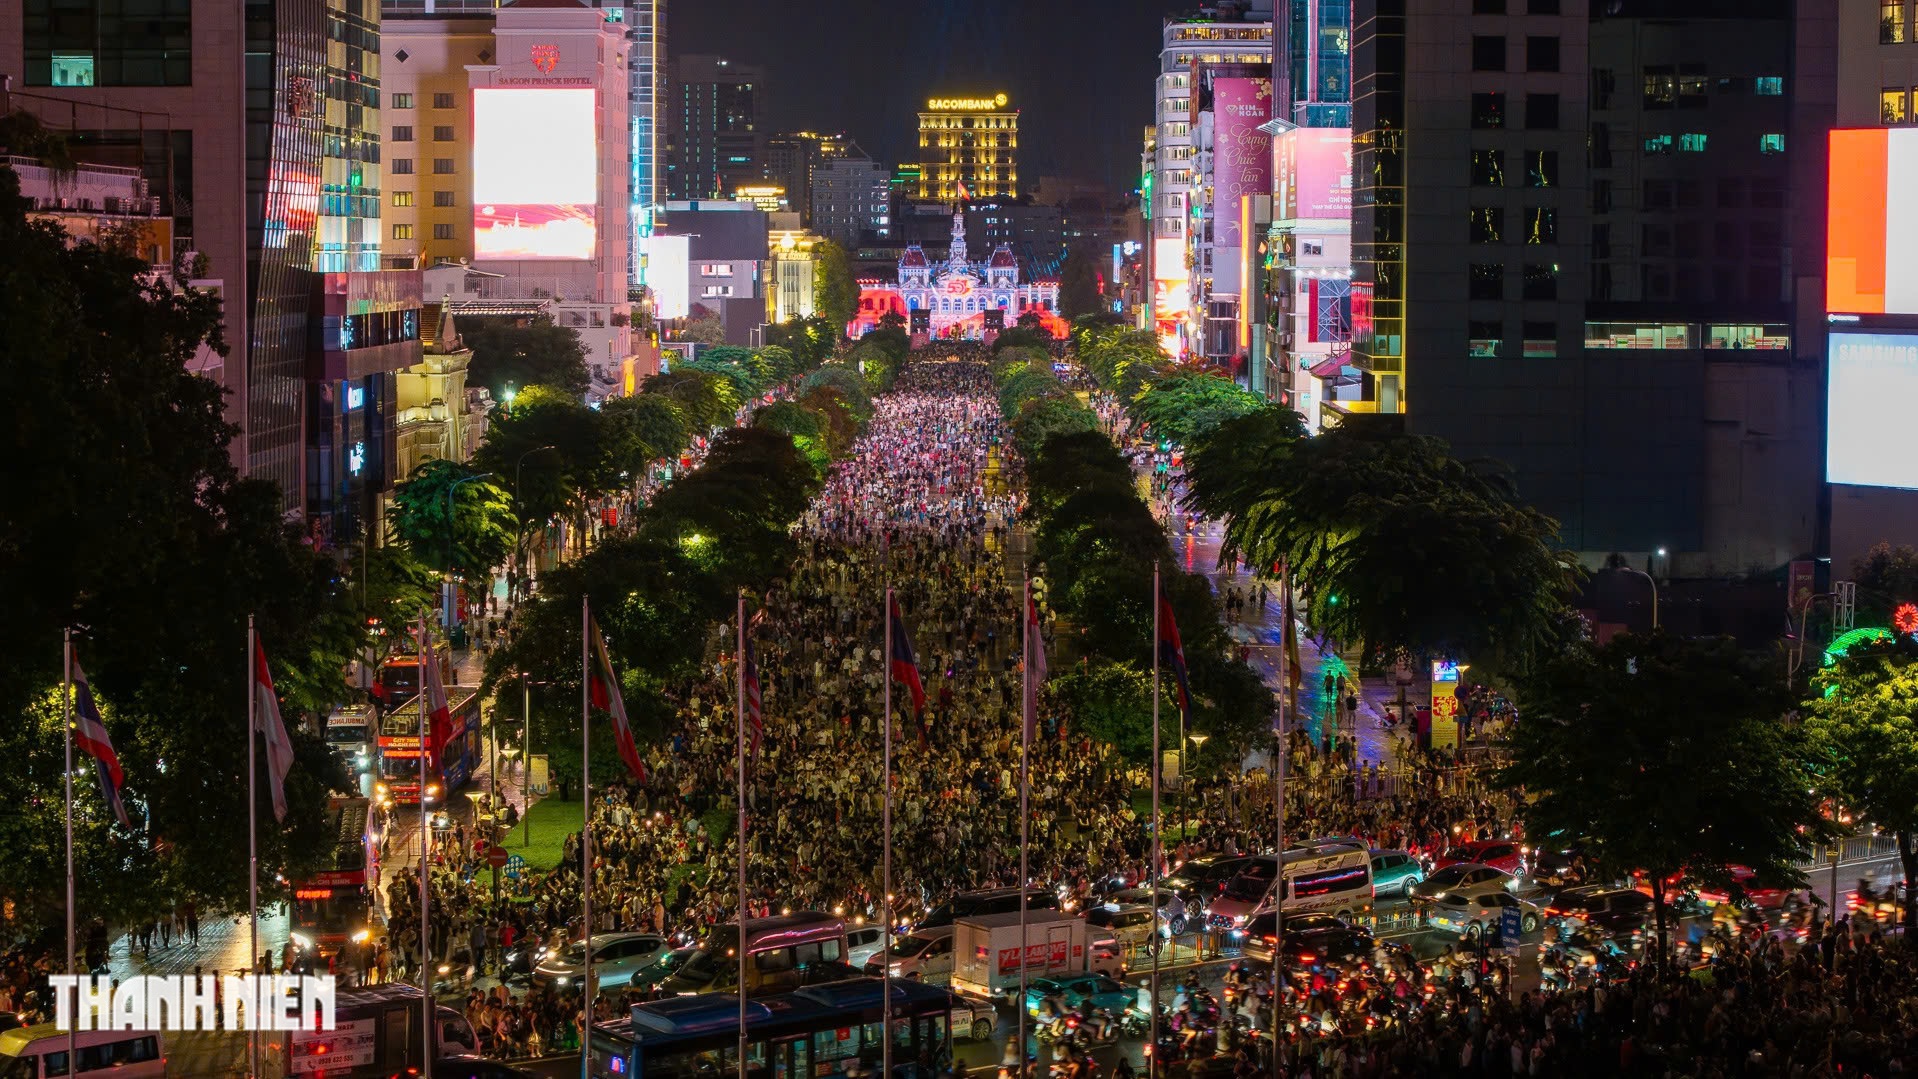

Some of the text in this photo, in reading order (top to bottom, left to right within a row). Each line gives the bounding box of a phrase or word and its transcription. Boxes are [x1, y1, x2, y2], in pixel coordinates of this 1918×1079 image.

[563, 77, 592, 85] HOTEL
[928, 99, 996, 109] SACOMBANK
[1297, 897, 1350, 909] Freedom
